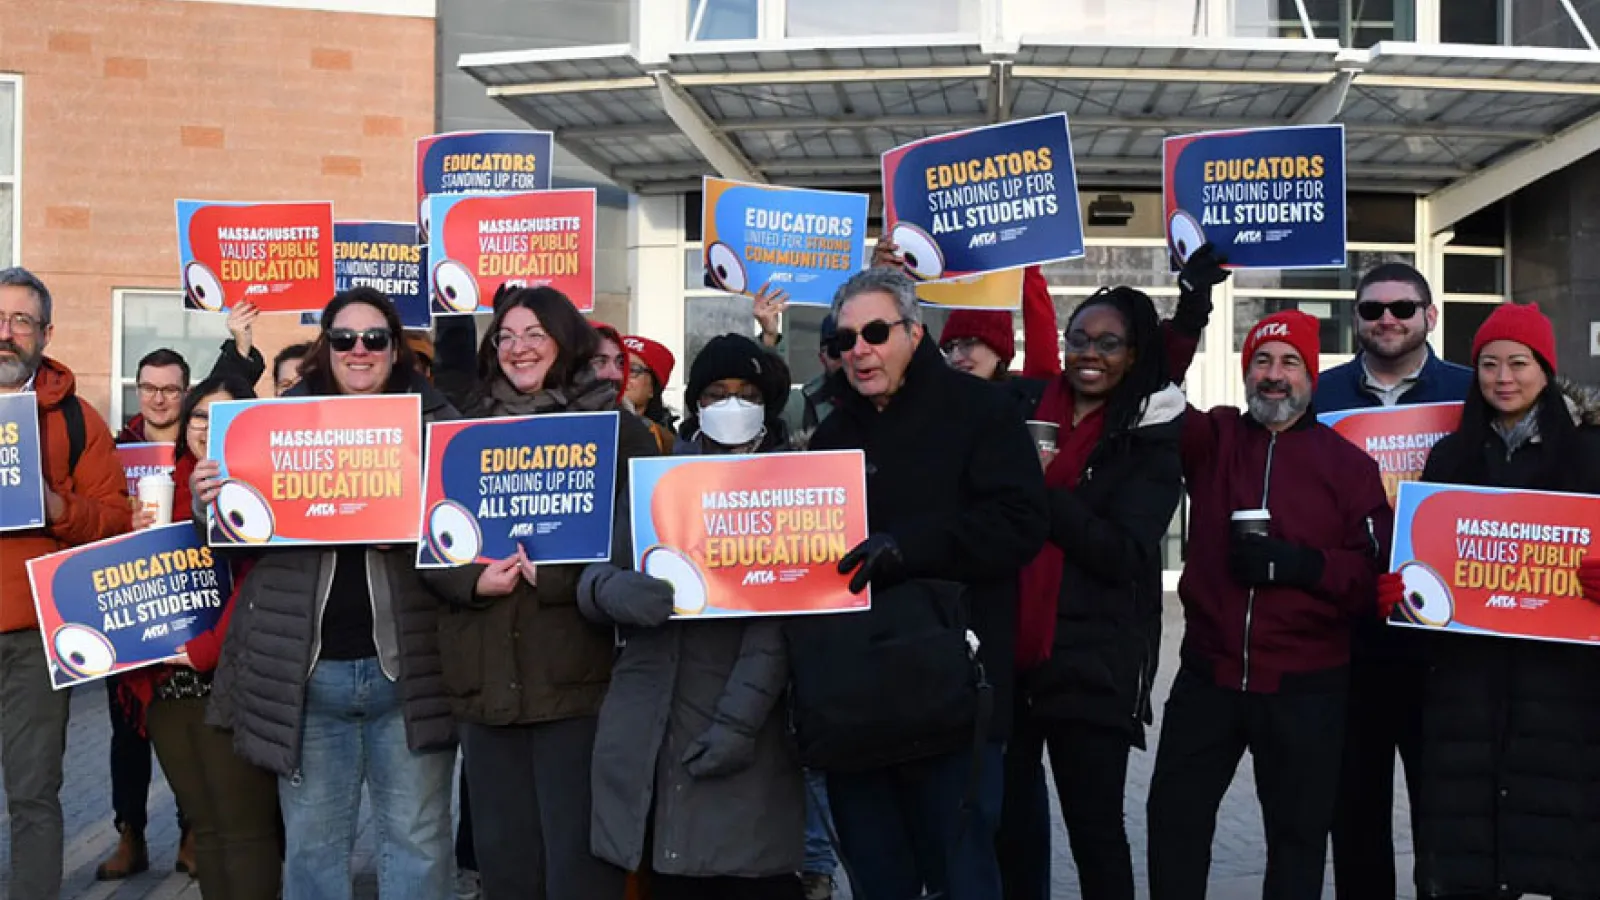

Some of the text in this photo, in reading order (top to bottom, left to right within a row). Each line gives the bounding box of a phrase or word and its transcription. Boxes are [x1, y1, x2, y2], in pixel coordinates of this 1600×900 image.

[443, 153, 536, 172] EDUCATORS
[926, 147, 1053, 191] EDUCATORS
[1203, 154, 1325, 183] EDUCATORS
[441, 173, 534, 189] STANDING UP FOR
[928, 172, 1056, 212] STANDING UP FOR
[1202, 180, 1324, 203] STANDING UP FOR
[478, 216, 580, 234] MASSACHUSETTS
[745, 207, 853, 237] EDUCATORS
[932, 194, 1058, 235] ALL STUDENTS
[1201, 201, 1325, 226] ALL STUDENTS
[217, 226, 320, 241] MASSACHUSETTS
[478, 233, 578, 254] VALUES PUBLIC
[744, 230, 851, 253] UNITED FOR STRONG
[219, 241, 318, 260] VALUES PUBLIC
[334, 242, 421, 262] EDUCATORS
[745, 245, 851, 271] COMMUNITIES
[220, 258, 320, 281] EDUCATION
[335, 260, 420, 279] TANDING UP FOR
[478, 252, 579, 277] EDUCATION
[335, 276, 349, 292] LL
[269, 428, 402, 447] MASSACHUSETTS
[271, 447, 400, 472] VALUES PUBLIC
[480, 442, 597, 473] EDUCATORS
[272, 470, 402, 501] EDUCATION
[478, 470, 595, 495] STANDING UP FOR
[478, 492, 593, 519] ALL STUDENTS
[701, 486, 846, 509] MASSACHUSETTS
[703, 508, 845, 536] VALUES PUBLIC
[1456, 518, 1591, 545] MASSACHUSETTS
[704, 532, 847, 568] EDUCATION
[1456, 538, 1518, 564] VALUES
[92, 547, 214, 592] EDUCATORS
[1454, 560, 1585, 597] EDUCATION
[97, 569, 218, 611] STANDING UP FOR
[103, 590, 221, 632] ALL STUDENTS
